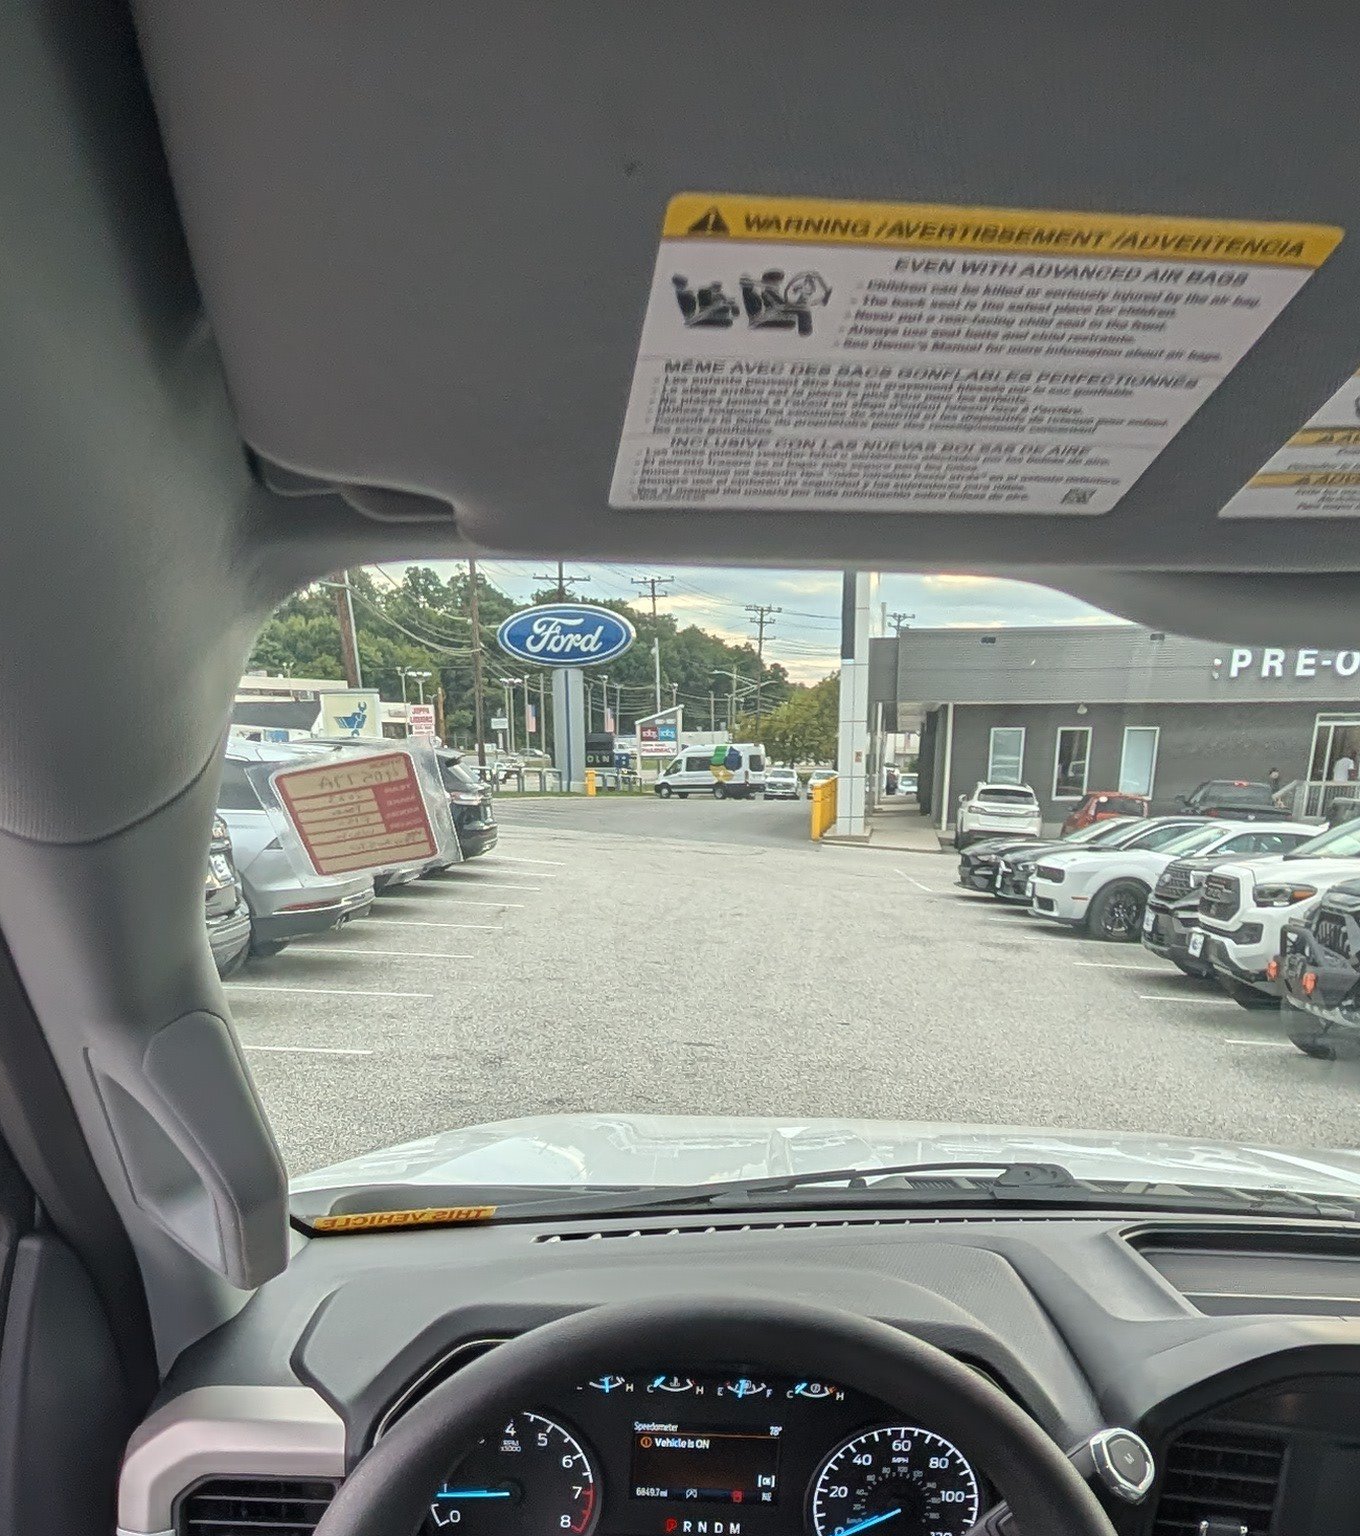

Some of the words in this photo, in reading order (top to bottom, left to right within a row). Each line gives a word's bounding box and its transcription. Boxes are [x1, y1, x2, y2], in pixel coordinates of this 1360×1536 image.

[744, 214, 871, 237] WARNING
[892, 257, 957, 274] EVEN
[958, 260, 1018, 277] WITH
[1017, 263, 1143, 282] ADVANCED
[1141, 269, 1184, 284] AIR
[1182, 271, 1251, 287] BAGS
[525, 617, 604, 652] Ford
[505, 1421, 516, 1436] 4
[634, 1421, 678, 1432] Speedometer
[537, 1433, 548, 1447] 5
[654, 1438, 687, 1448] Vehicle
[687, 1438, 695, 1448] is
[695, 1438, 710, 1449] ON
[892, 1440, 911, 1452] 60
[562, 1455, 573, 1468] 6
[852, 1454, 872, 1466] 40
[929, 1457, 949, 1469] 80
[572, 1486, 583, 1499] 7
[829, 1486, 848, 1498] 20
[940, 1491, 965, 1502] 100
[450, 1510, 461, 1522] 0
[560, 1515, 571, 1528] 8
[665, 1518, 677, 1532] P
[683, 1521, 692, 1532] R
[698, 1522, 707, 1533] N
[714, 1522, 723, 1533] D
[730, 1523, 740, 1534] M
